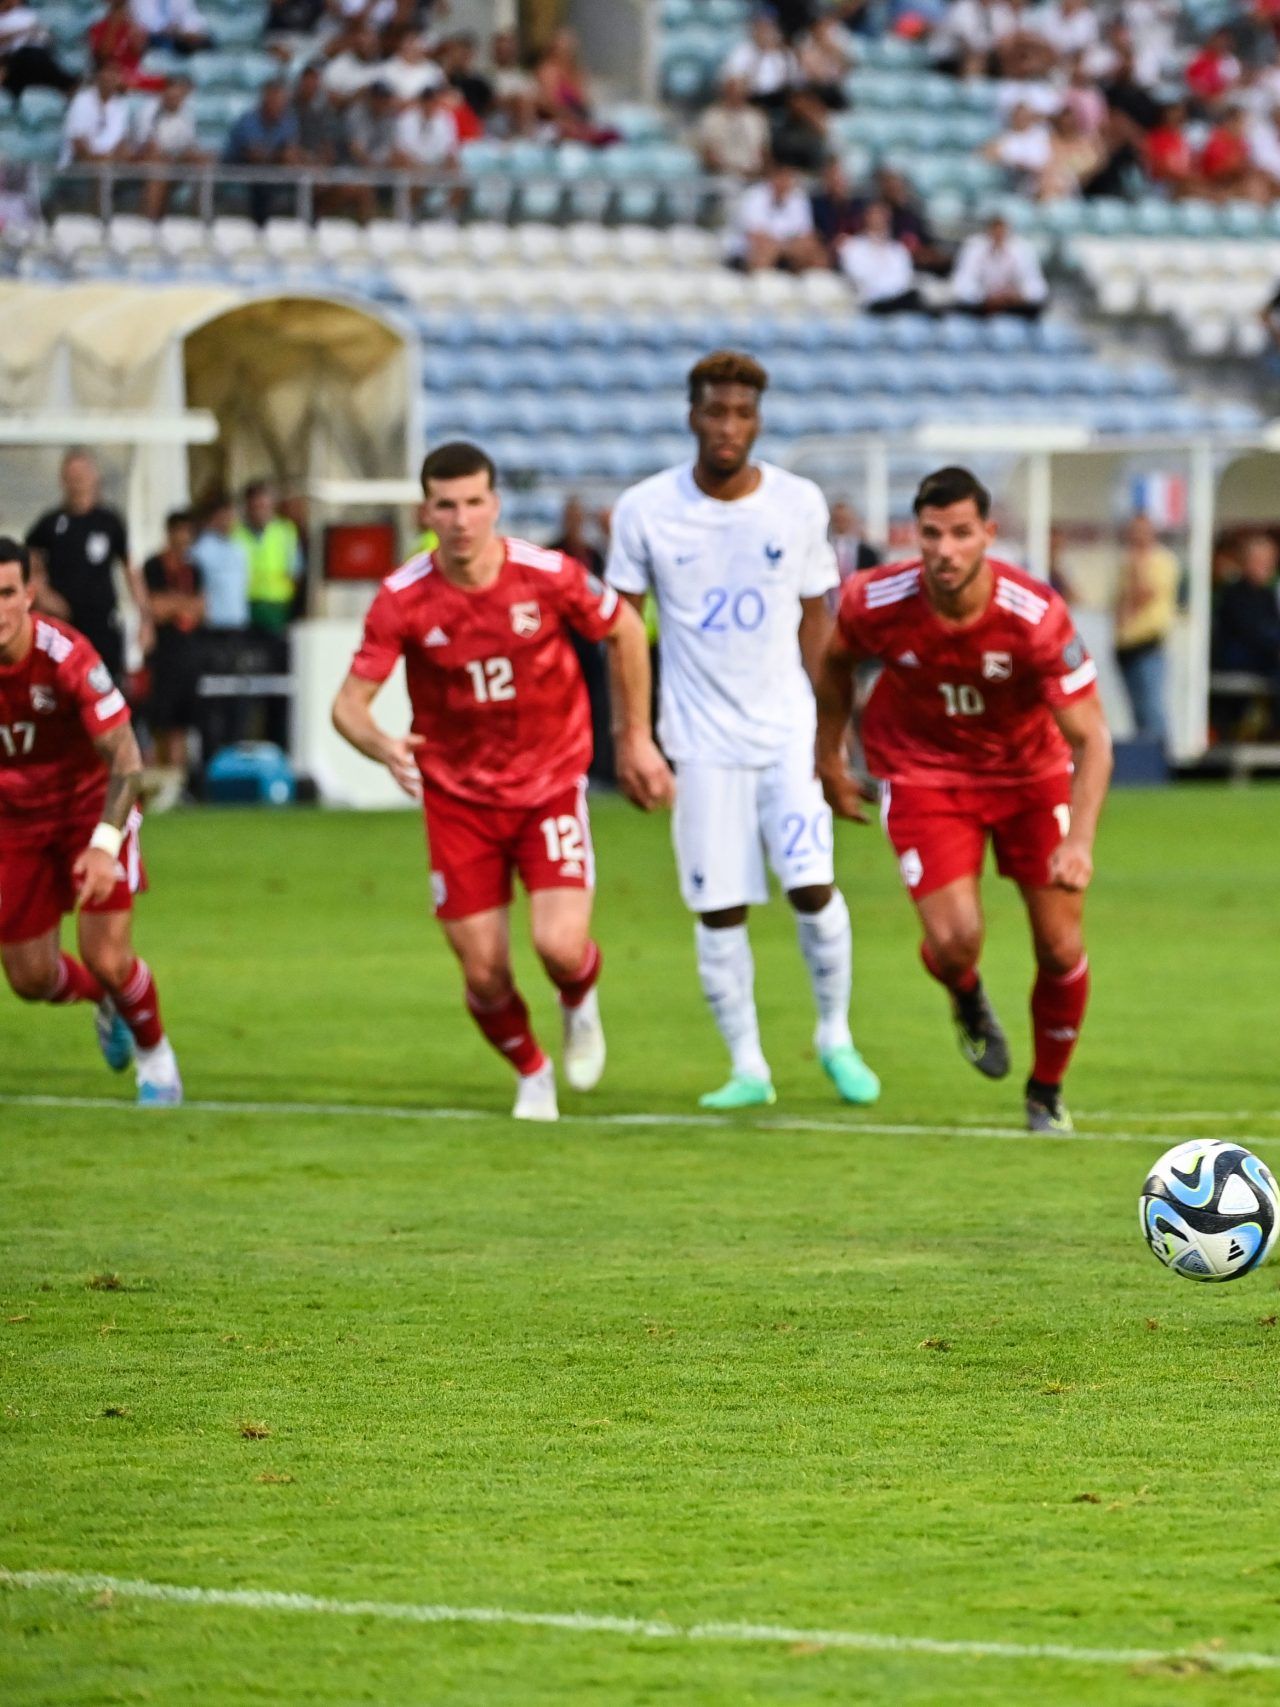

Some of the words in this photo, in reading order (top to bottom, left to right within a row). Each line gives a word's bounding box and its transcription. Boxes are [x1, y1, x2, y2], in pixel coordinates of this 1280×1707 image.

[700, 586, 766, 633] 20
[466, 656, 516, 704] 12
[938, 682, 986, 718] 10
[0, 721, 36, 758] 17
[540, 814, 587, 862] 12
